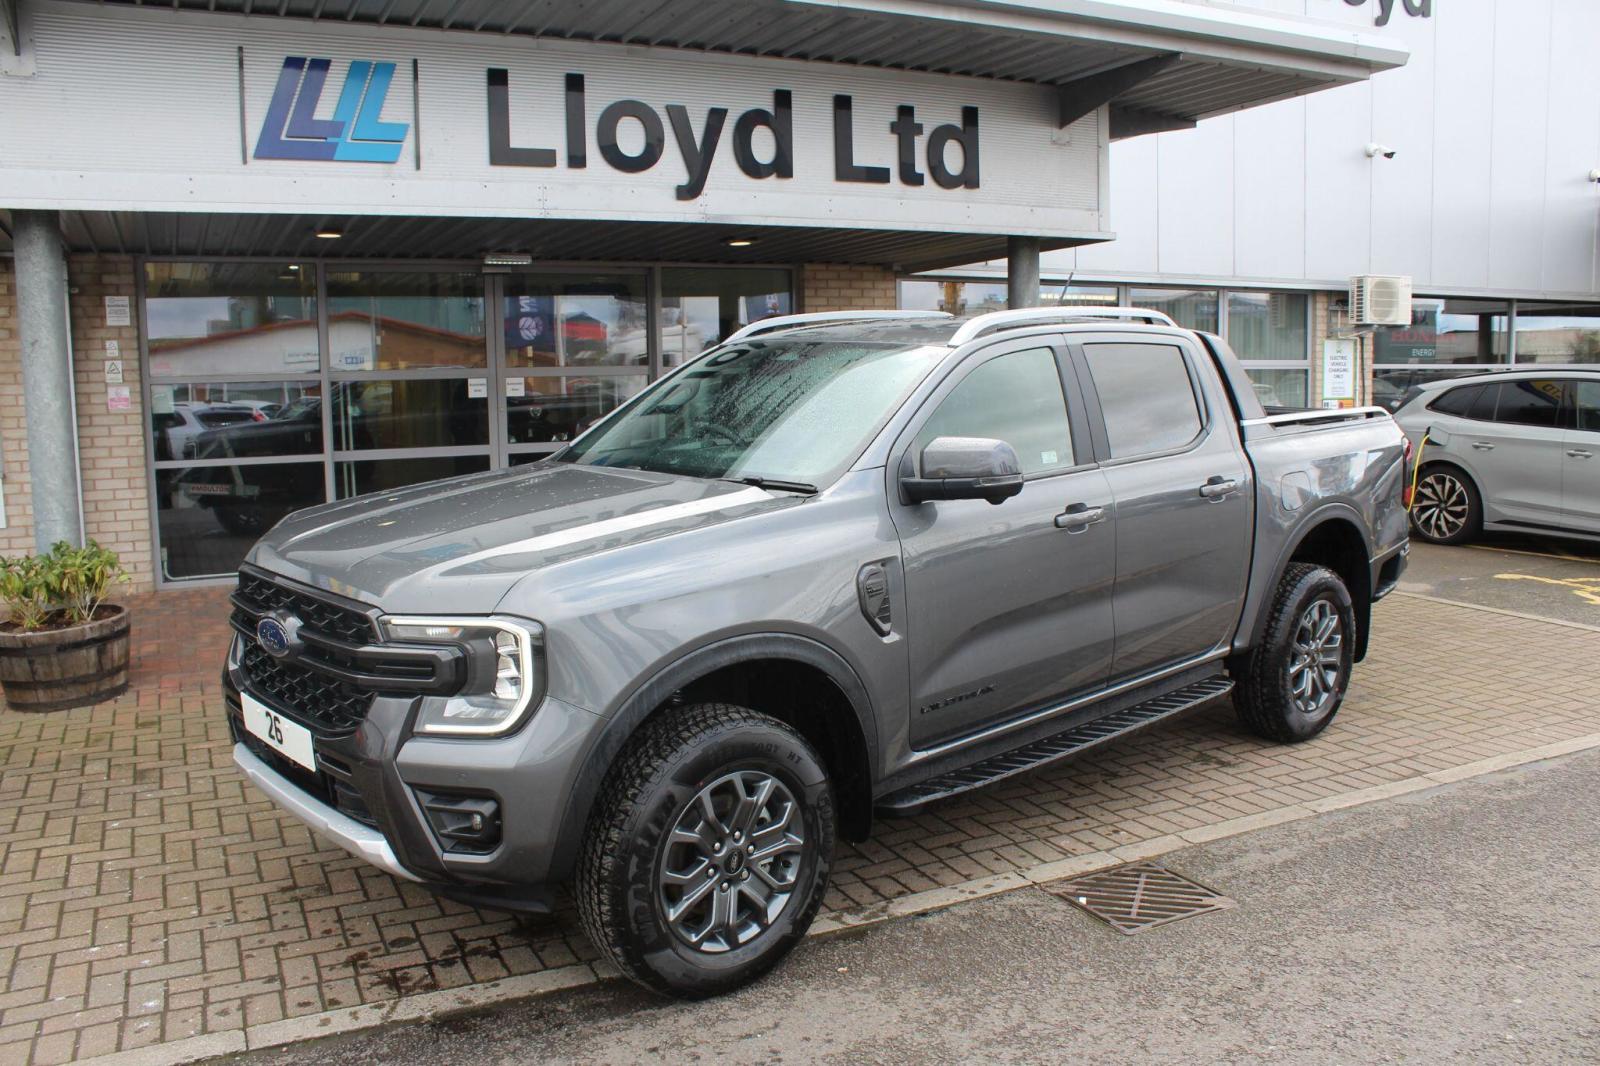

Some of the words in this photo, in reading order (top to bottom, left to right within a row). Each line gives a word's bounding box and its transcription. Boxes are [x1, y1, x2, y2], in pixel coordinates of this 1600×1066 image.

[488, 67, 794, 201] Lloyd
[834, 94, 980, 190] Ltd
[1411, 348, 1436, 357] ENERGY
[265, 711, 284, 745] 26
